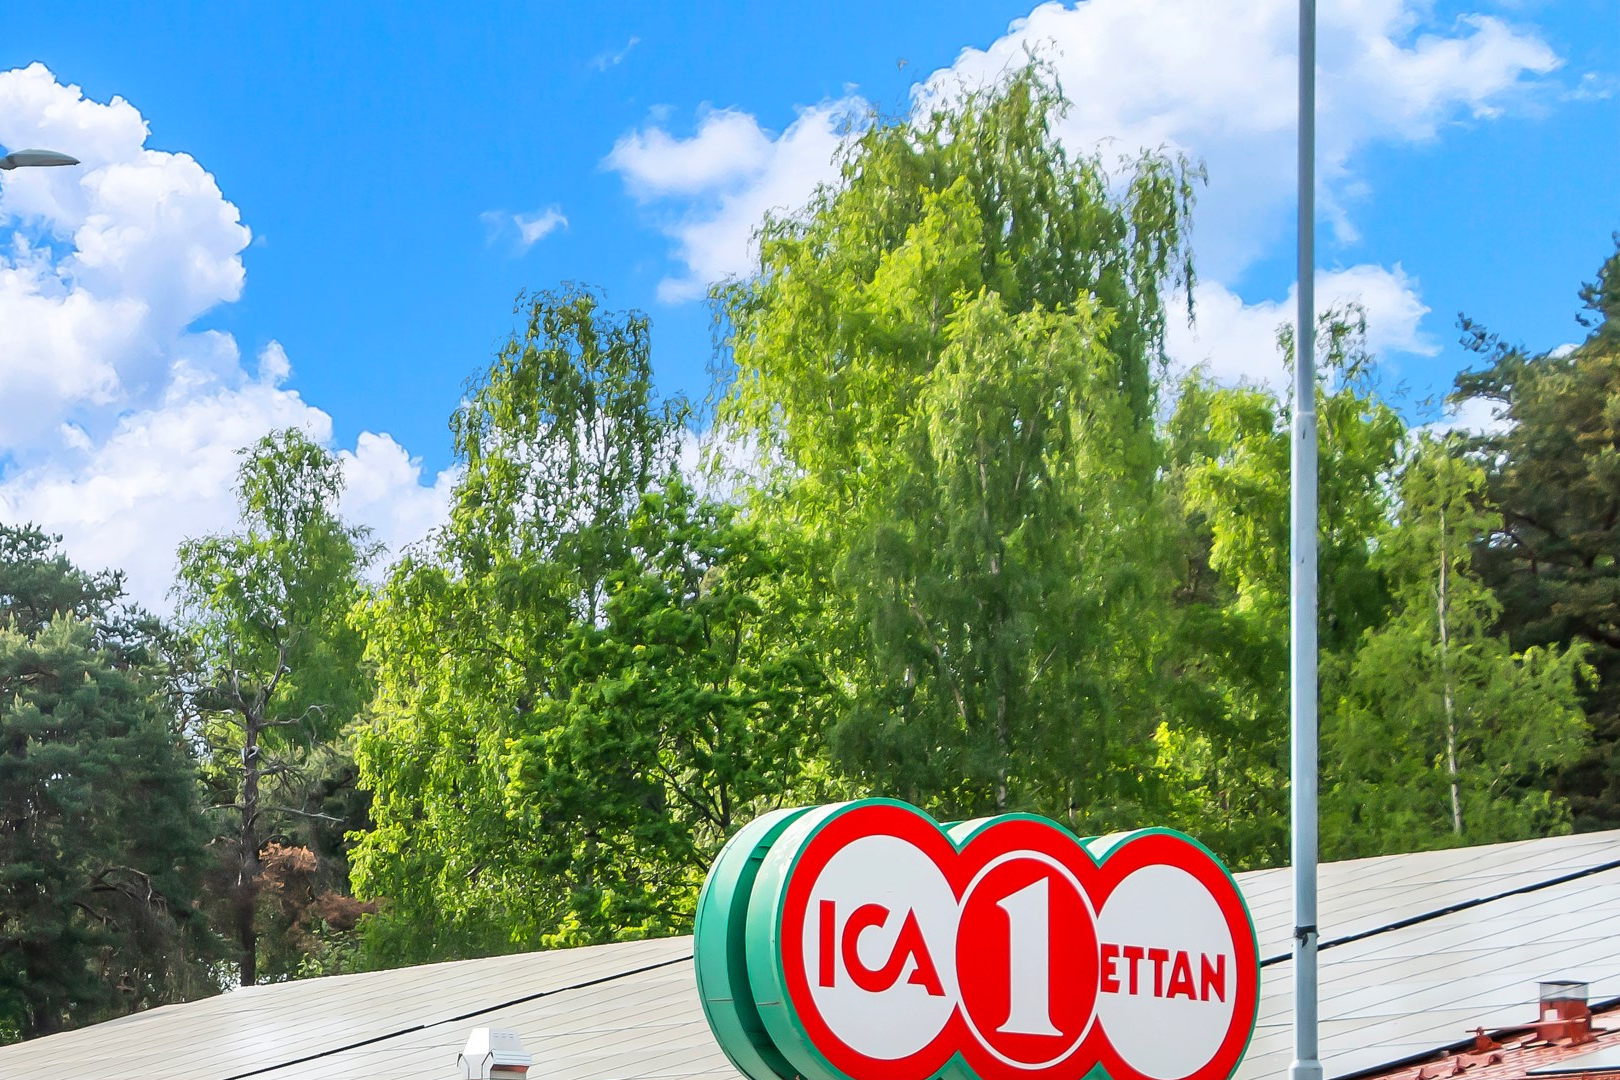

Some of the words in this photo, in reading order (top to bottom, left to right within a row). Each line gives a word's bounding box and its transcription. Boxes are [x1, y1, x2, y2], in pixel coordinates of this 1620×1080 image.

[818, 899, 947, 997] ICA
[995, 876, 1065, 1037] 1
[1099, 942, 1227, 1003] ETTAN
